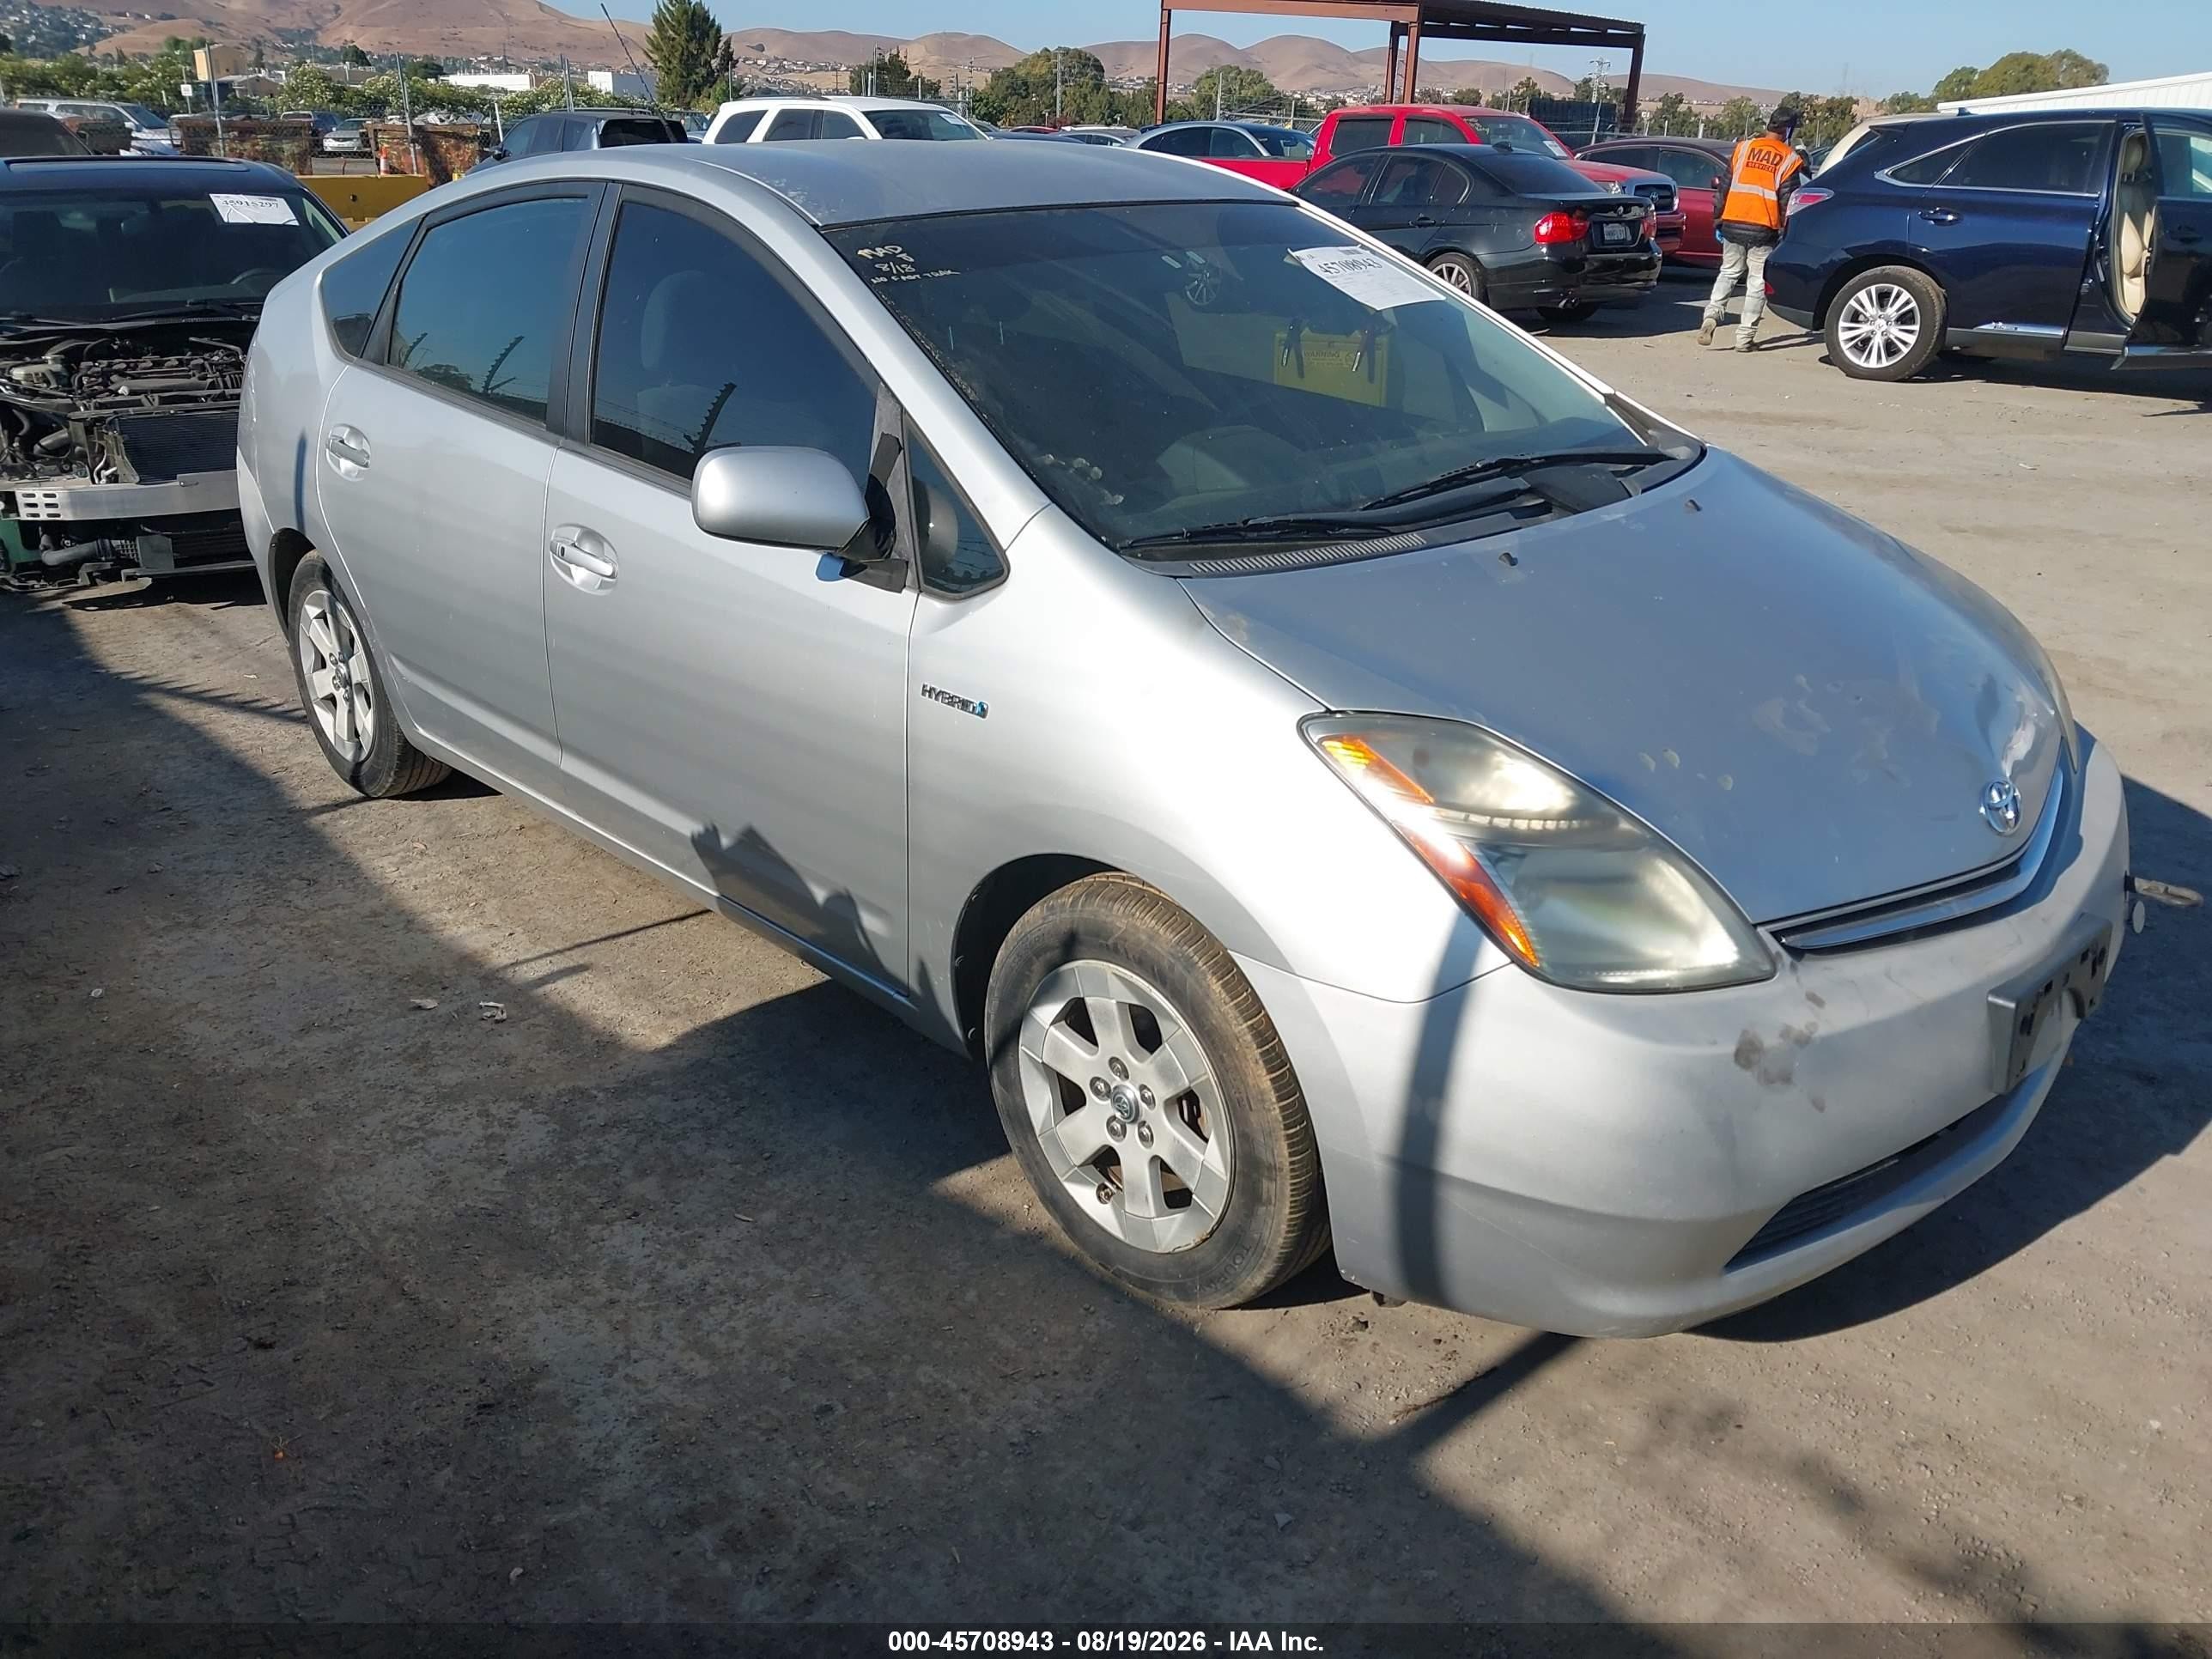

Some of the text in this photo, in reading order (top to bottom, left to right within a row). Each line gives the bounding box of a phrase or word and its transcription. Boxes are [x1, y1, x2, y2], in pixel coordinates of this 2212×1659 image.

[1747, 148, 1784, 166] MAD
[857, 246, 902, 258] MAD
[874, 262, 915, 274] 8/18
[1317, 258, 1382, 275] 45708943
[921, 684, 979, 715] HYBRID
